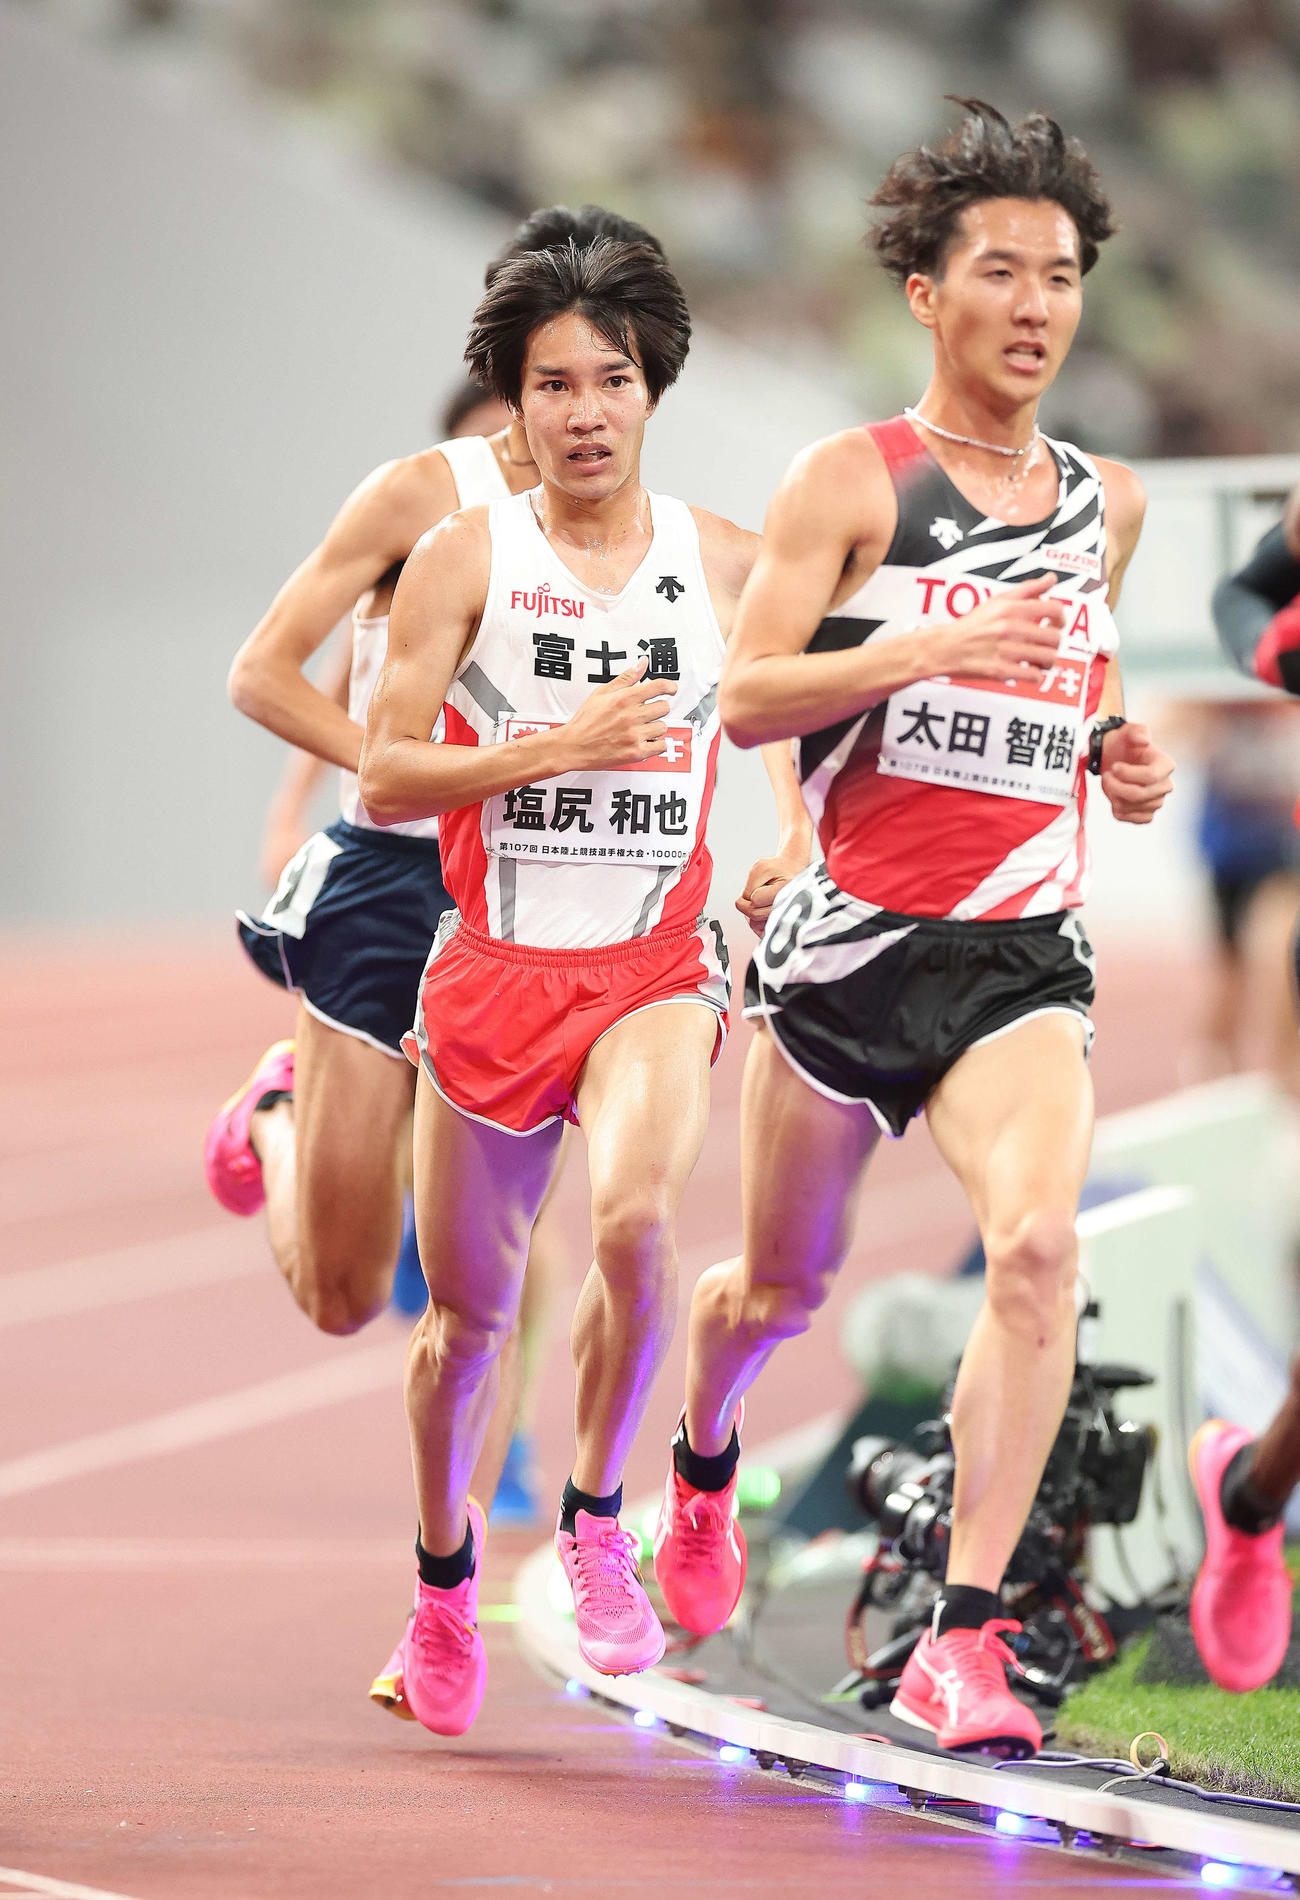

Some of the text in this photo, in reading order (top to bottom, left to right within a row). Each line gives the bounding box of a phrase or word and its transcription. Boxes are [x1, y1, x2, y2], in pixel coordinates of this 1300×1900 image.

[510, 582, 585, 619] FUJITSU
[532, 632, 681, 684] 富士通
[896, 701, 1076, 774] 太田 智樹
[502, 785, 689, 836] 塩尻 和也
[499, 842, 538, 854] 第107回
